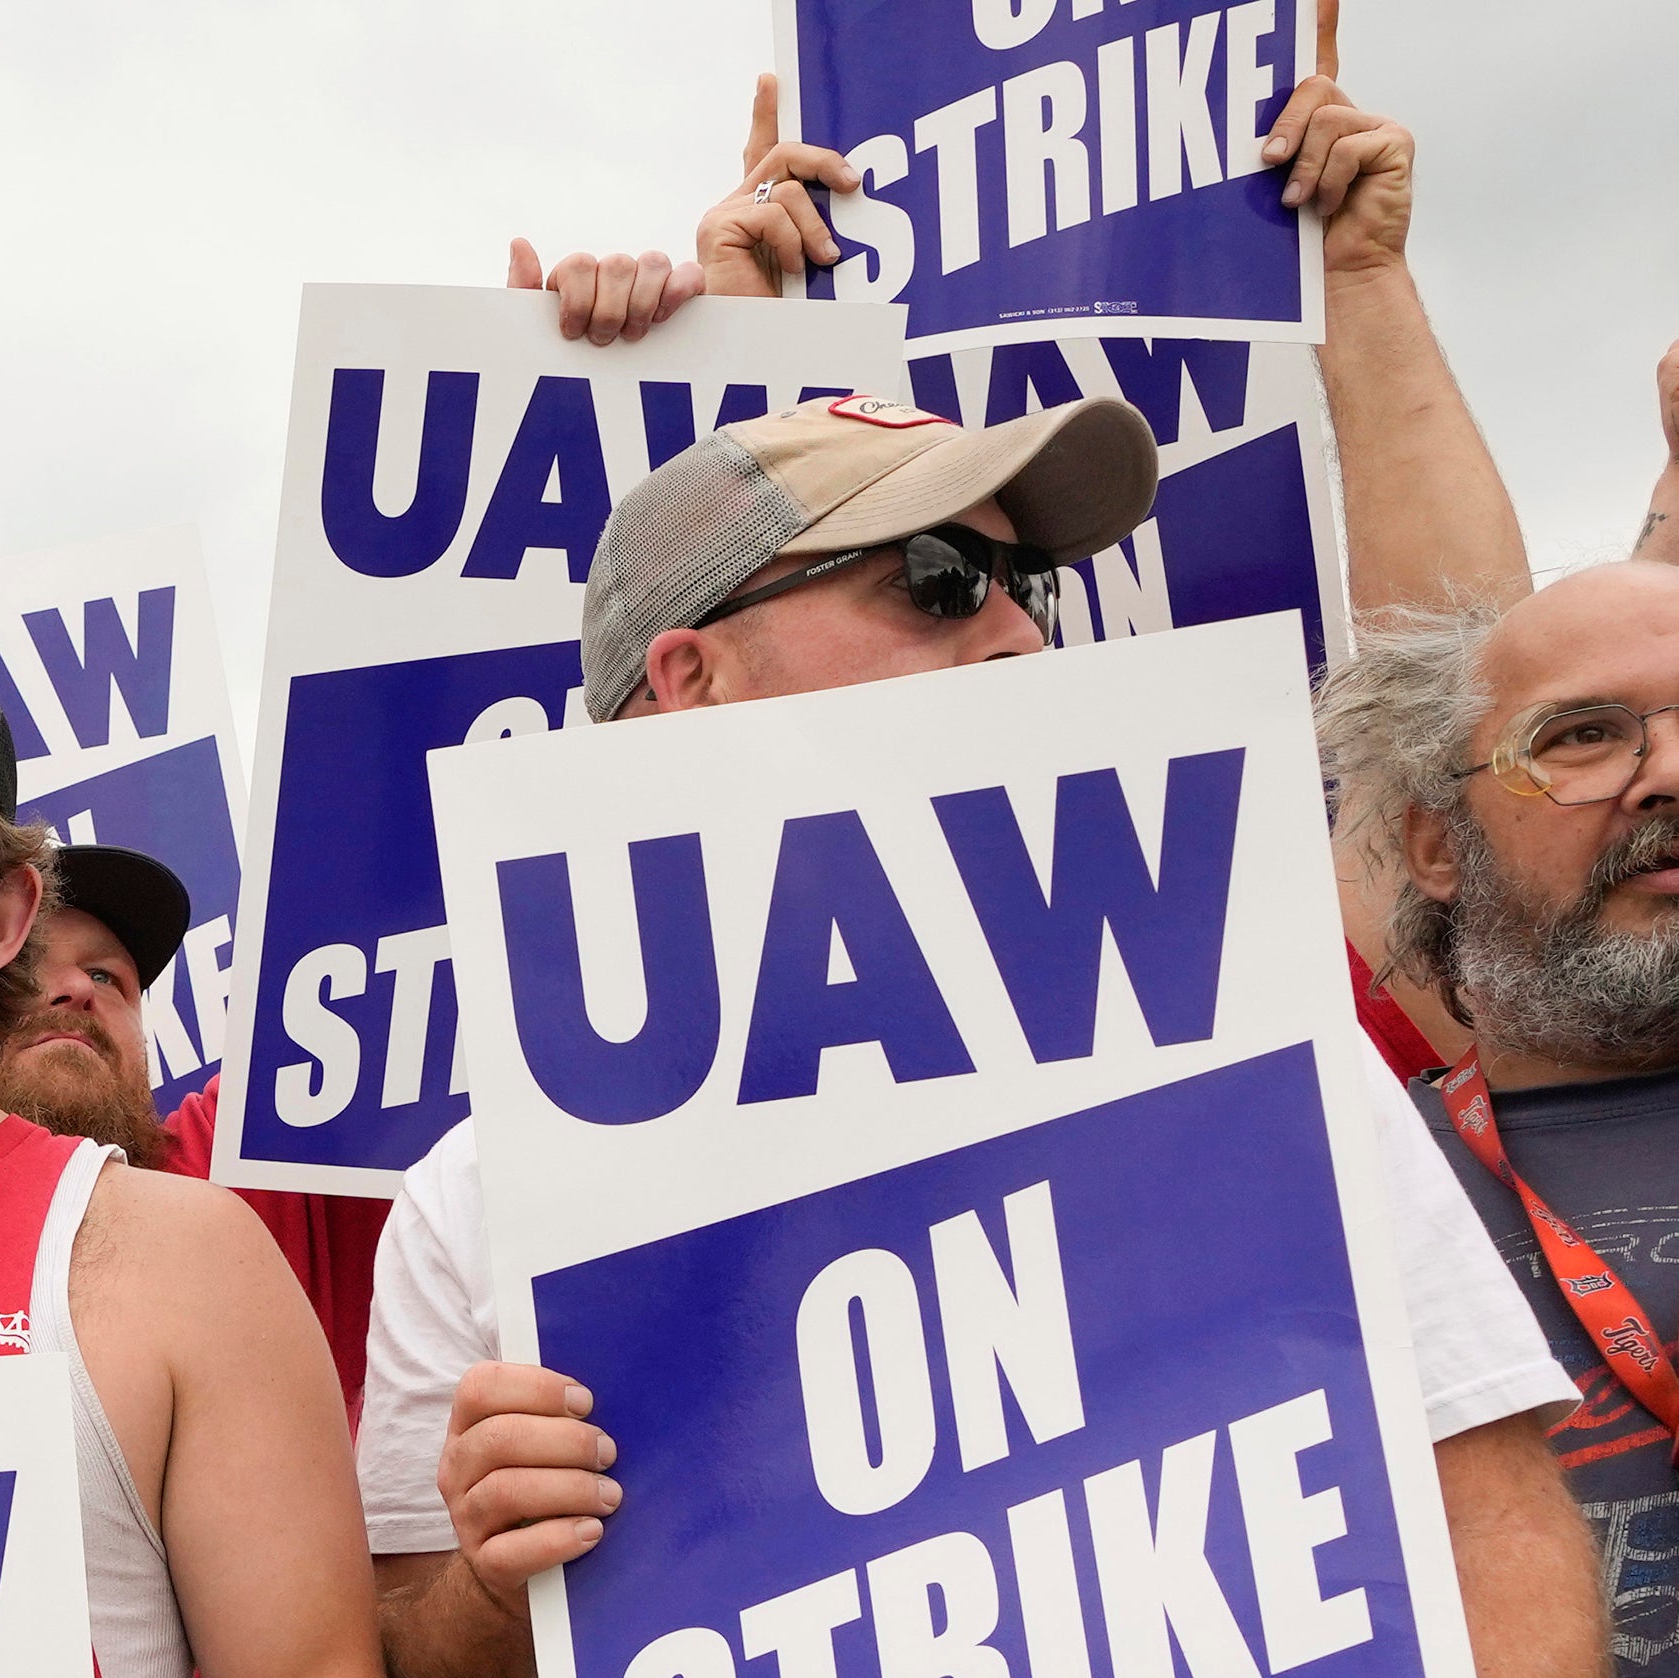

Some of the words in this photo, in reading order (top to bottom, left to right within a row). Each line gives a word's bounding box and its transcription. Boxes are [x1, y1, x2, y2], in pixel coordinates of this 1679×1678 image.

[829, 0, 1277, 304] STRIKE
[320, 368, 854, 584] UA
[908, 337, 1251, 447] AW
[494, 745, 1247, 1126] UAW
[794, 1179, 1086, 1517] ON
[1601, 1316, 1660, 1375] Tigers
